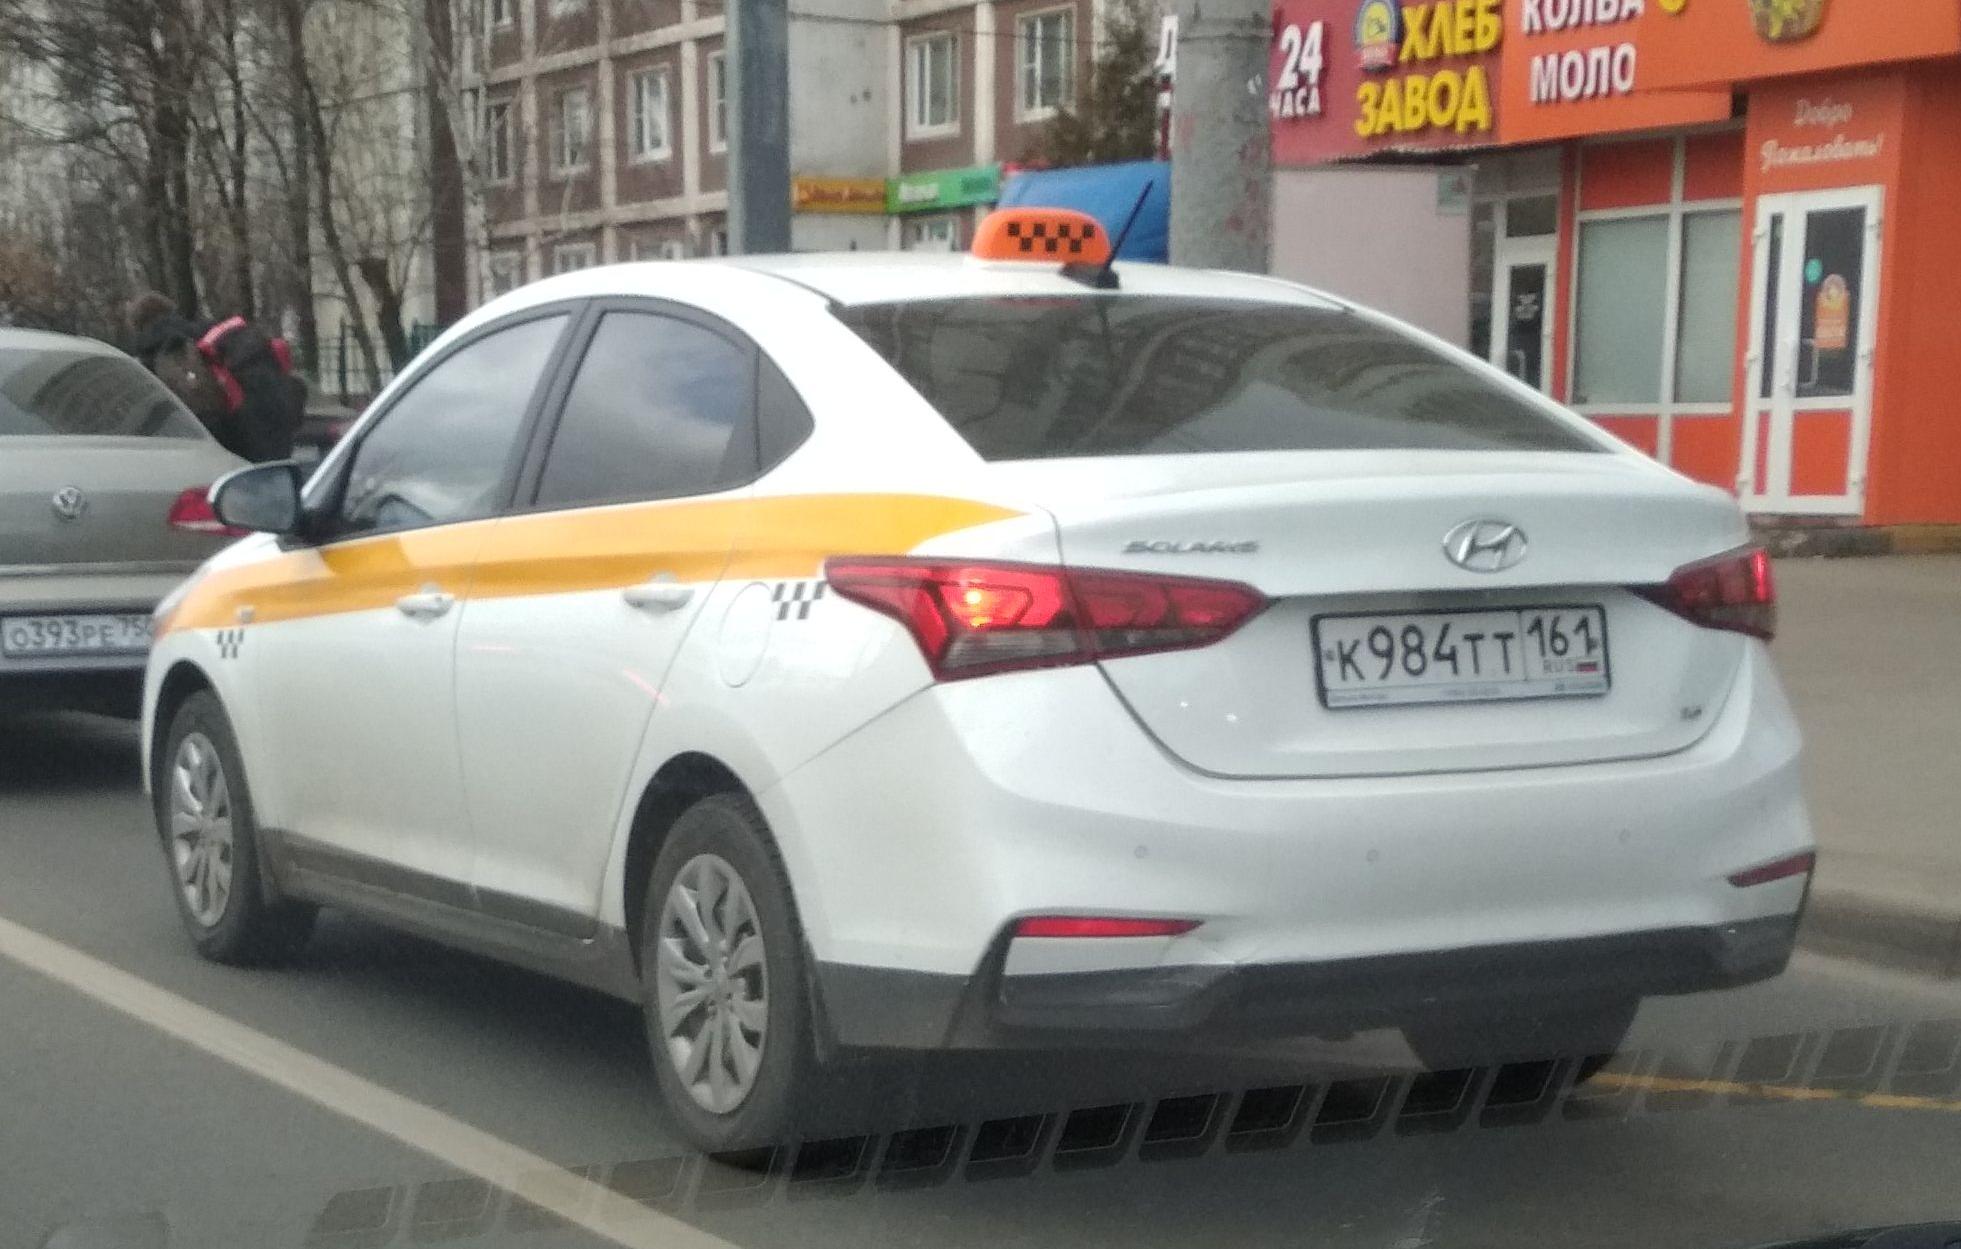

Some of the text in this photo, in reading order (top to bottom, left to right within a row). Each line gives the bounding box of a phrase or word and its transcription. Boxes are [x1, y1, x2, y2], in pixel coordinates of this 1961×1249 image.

[1276, 20, 1324, 91] 24
[1399, 0, 1503, 62] ХЛЕБ
[1355, 65, 1492, 138] ЗАВОД
[1530, 42, 1637, 102] МОЛО
[1336, 615, 1593, 681] К984ТТ 161
